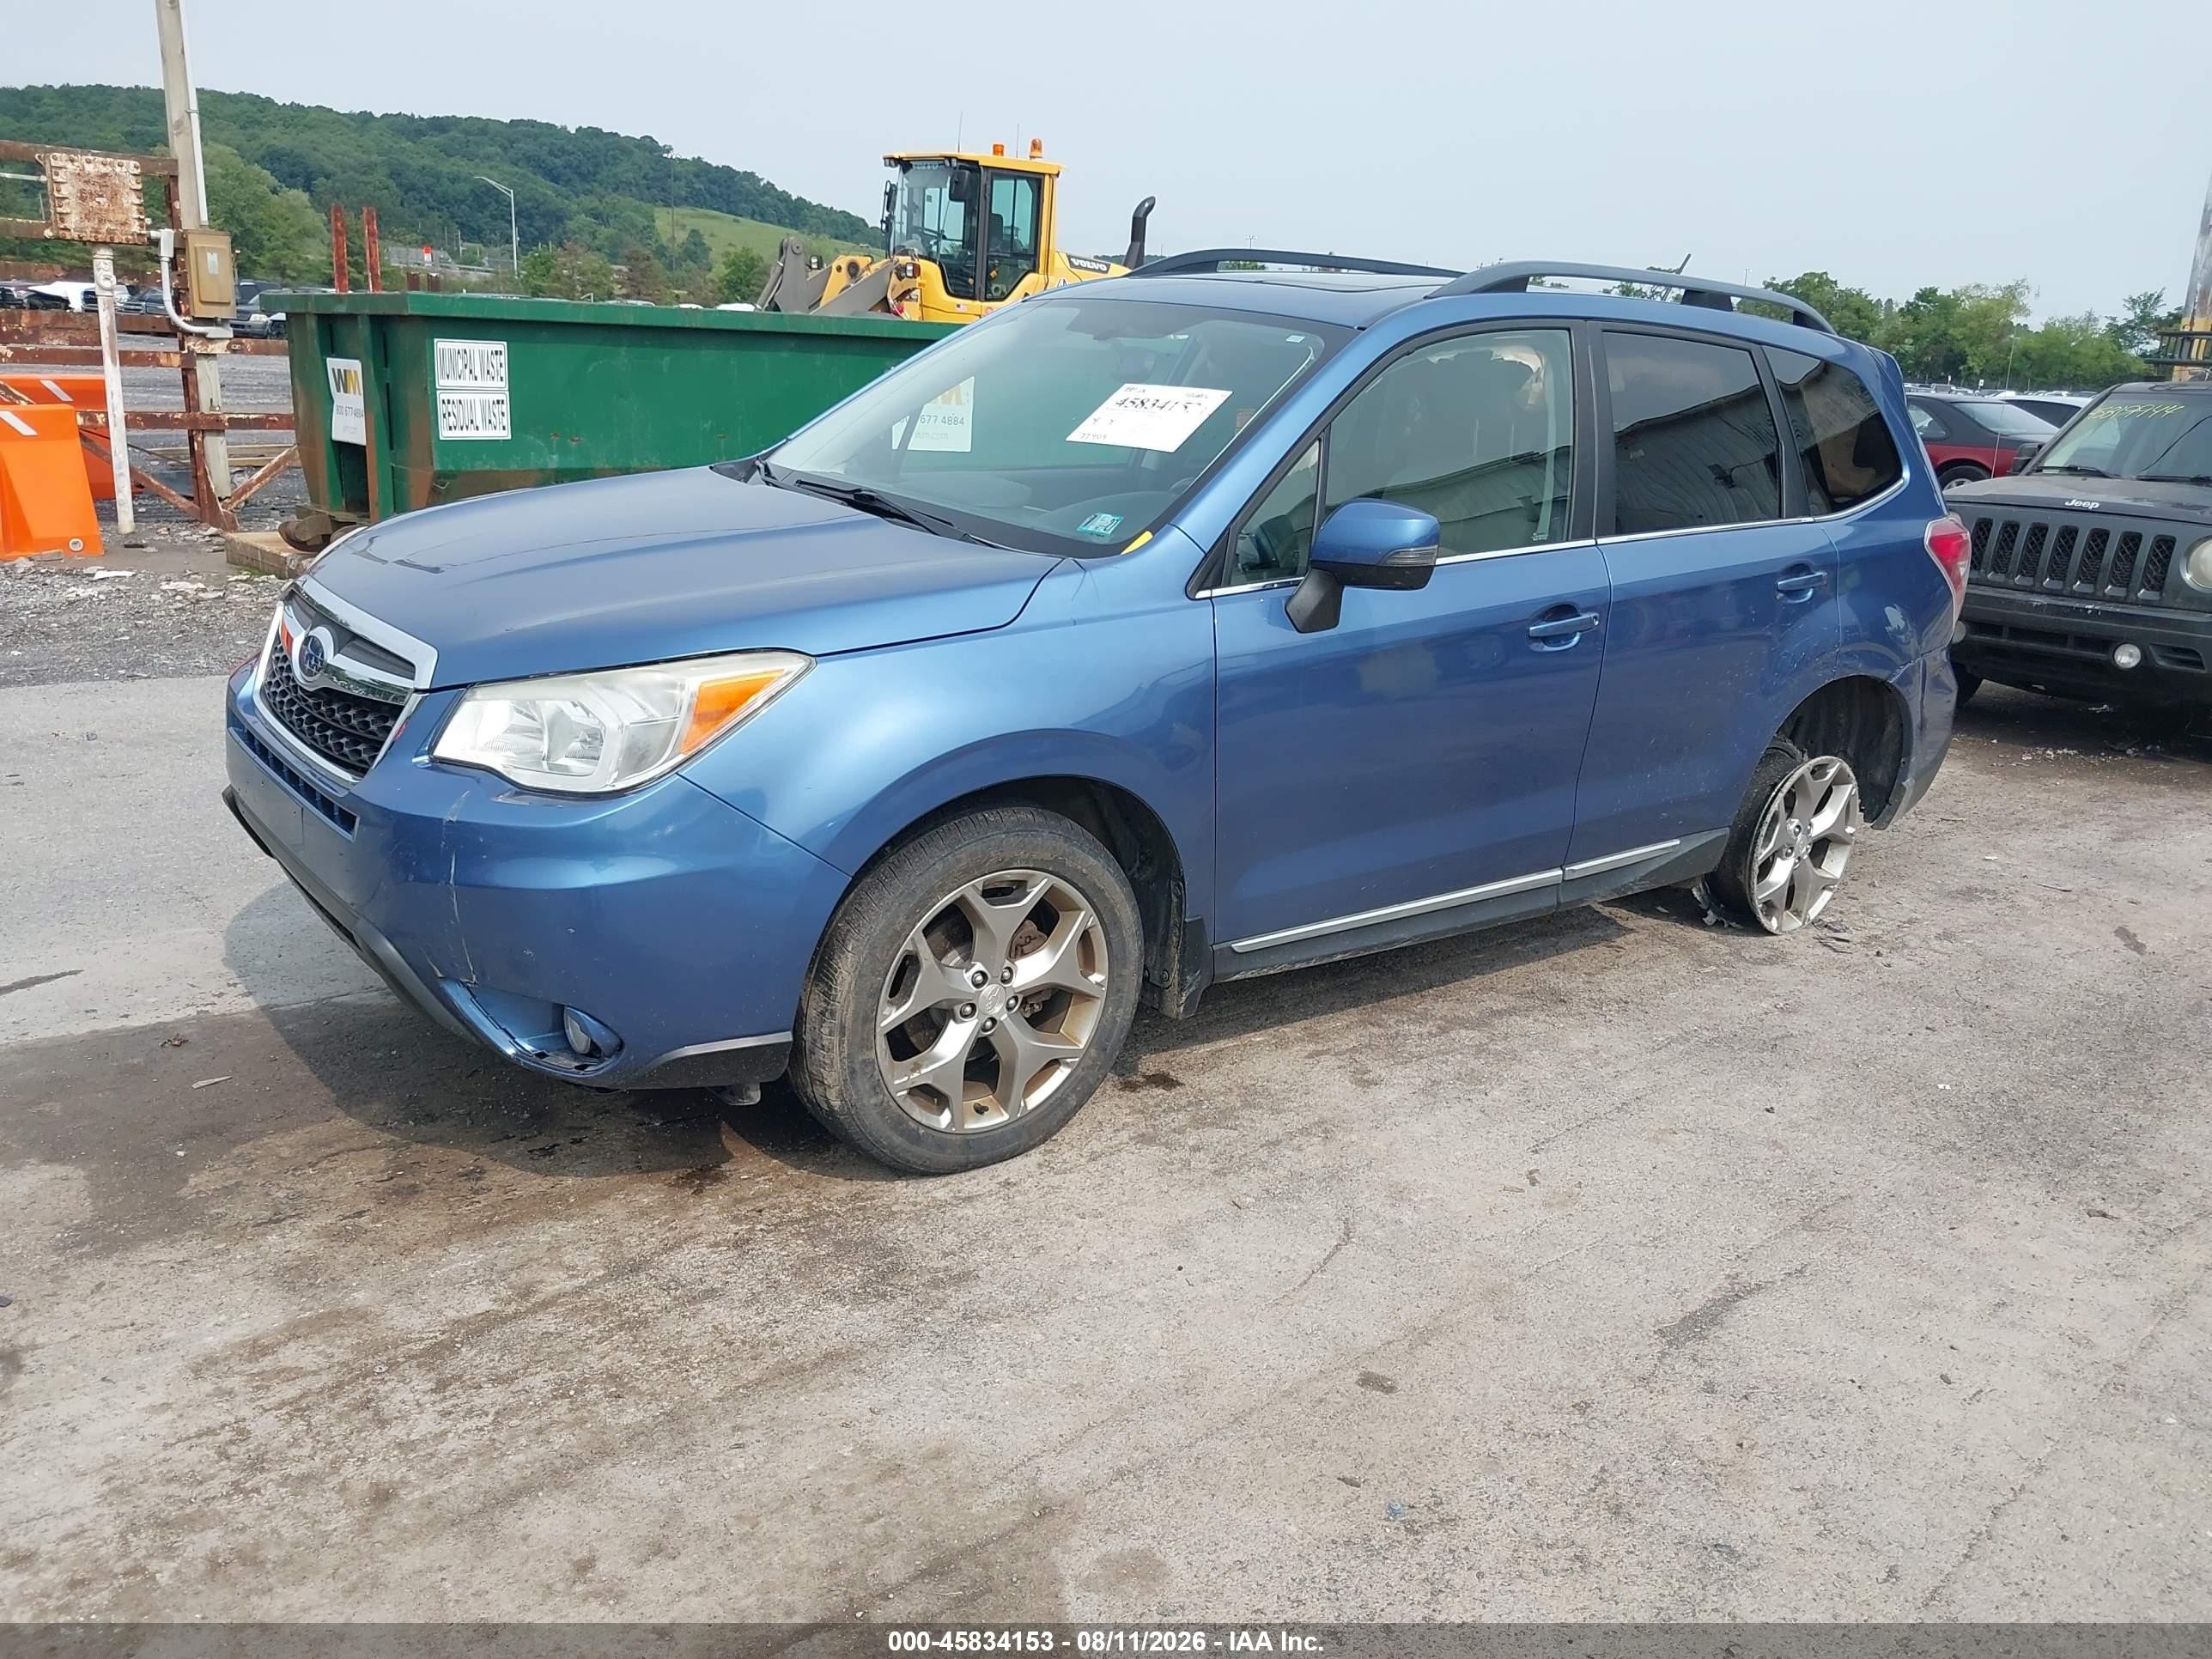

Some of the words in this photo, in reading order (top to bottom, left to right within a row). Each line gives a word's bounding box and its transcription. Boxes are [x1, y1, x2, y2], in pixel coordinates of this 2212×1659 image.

[1070, 258, 1108, 271] VOLVO
[438, 347, 478, 381] MUNICIPAL
[478, 349, 504, 382] WASTE
[331, 368, 362, 396] WM
[441, 398, 479, 431] RESIDUAL
[479, 398, 506, 431] WASTE
[920, 415, 939, 424] 677
[941, 416, 965, 426] 4884
[2064, 499, 2100, 510] Jeep
